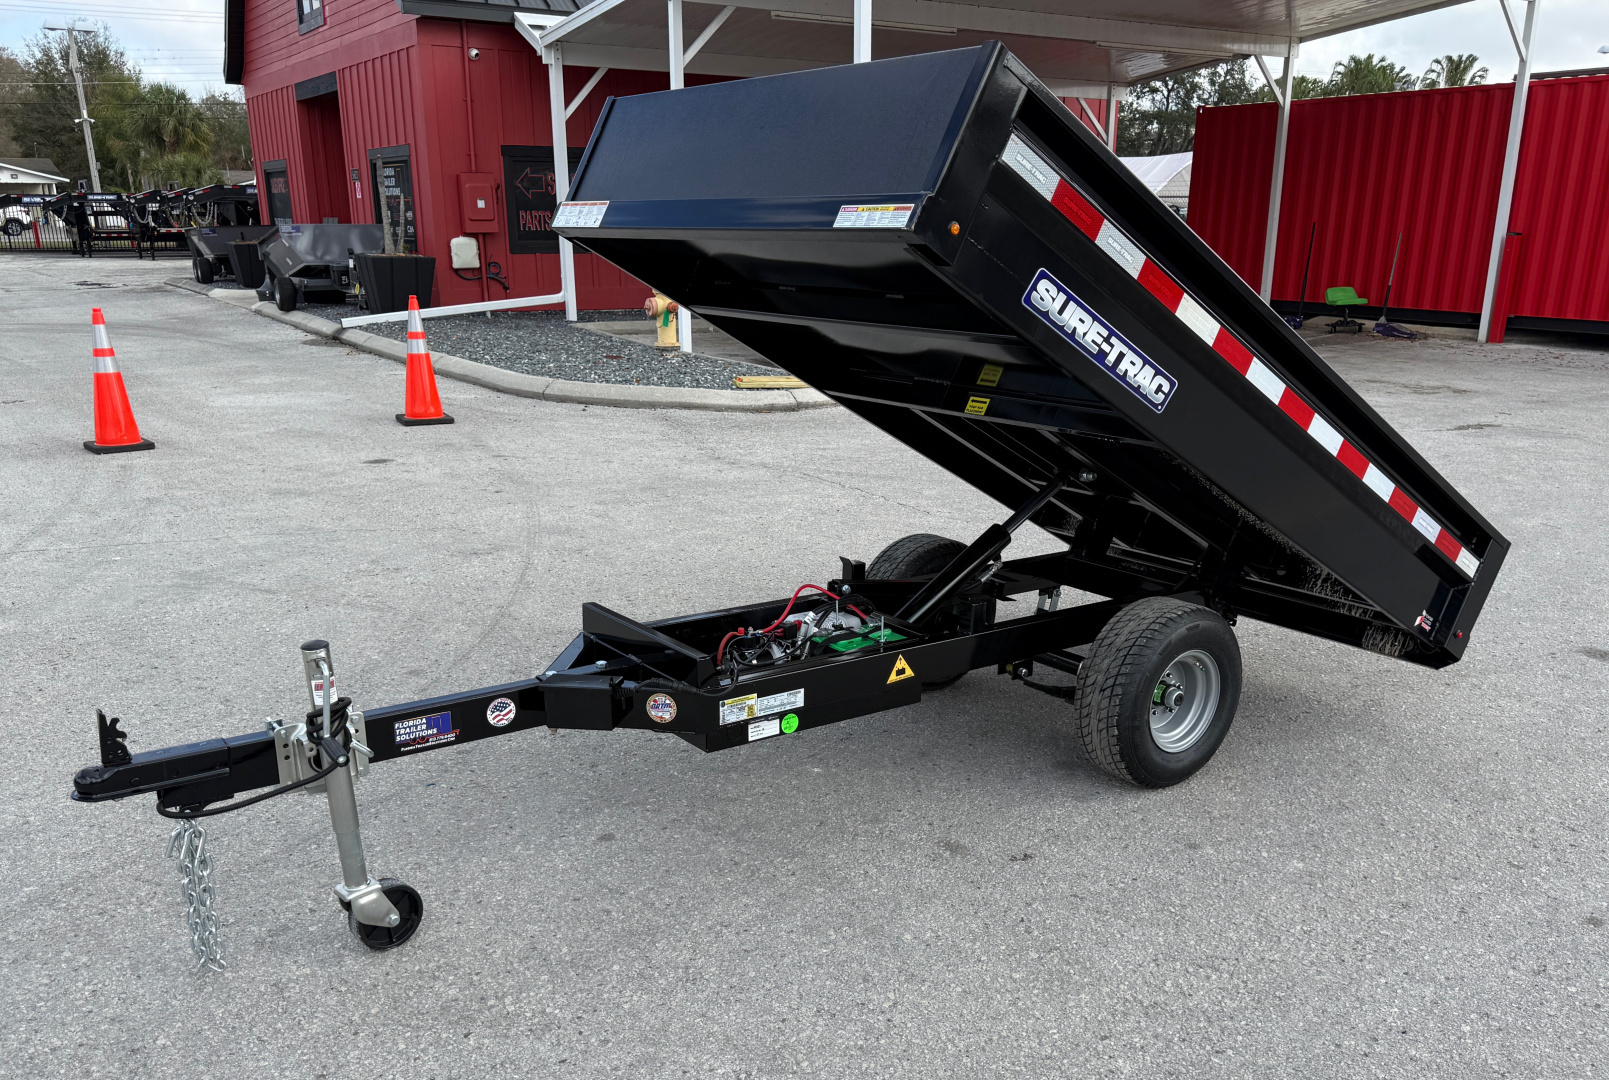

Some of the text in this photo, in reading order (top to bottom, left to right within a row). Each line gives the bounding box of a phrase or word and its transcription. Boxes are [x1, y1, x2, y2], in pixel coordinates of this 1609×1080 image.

[1015, 152, 1047, 185] SURE-TRAC
[519, 210, 552, 231] PARTS
[1063, 196, 1092, 225] SURE-TRAC
[1107, 236, 1134, 263] SURE-TRAC
[1030, 278, 1171, 404] SURE-TRAC
[395, 717, 427, 729] FLORIDA
[396, 724, 427, 735] TRAILER
[396, 728, 437, 742] SOLUTIONS
